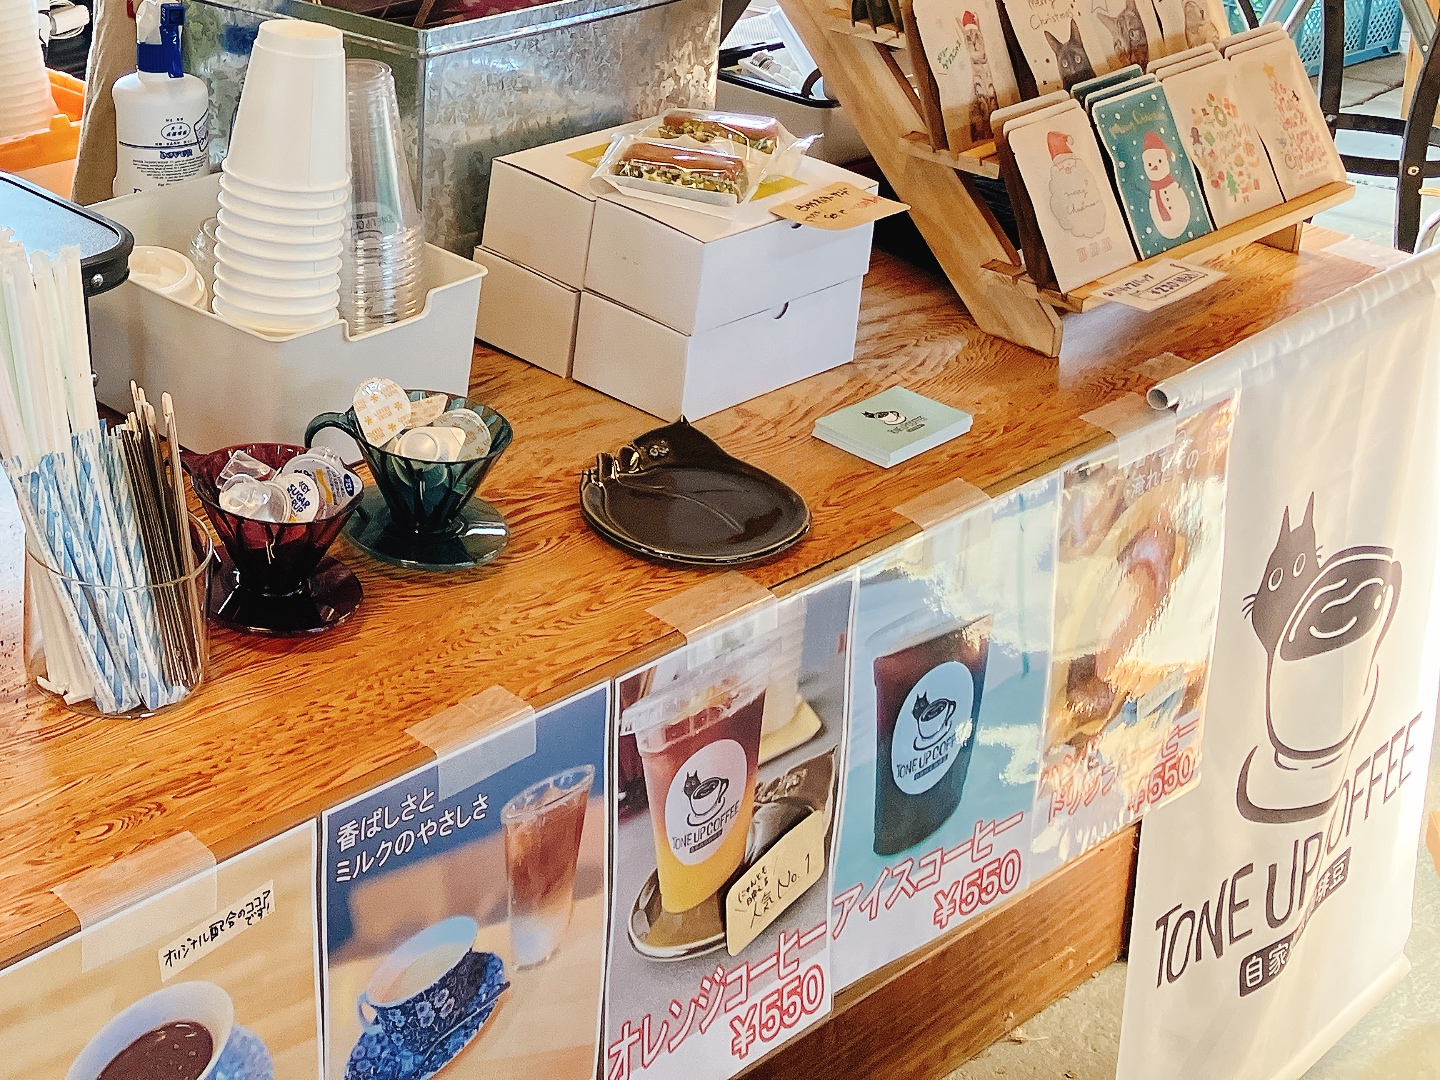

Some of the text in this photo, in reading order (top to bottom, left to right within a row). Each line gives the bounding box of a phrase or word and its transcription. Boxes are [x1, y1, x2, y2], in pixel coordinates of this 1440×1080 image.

[287, 484, 310, 509] SUGAR
[896, 755, 917, 779] TONE
[336, 787, 435, 852] 香ばしさと
[336, 793, 489, 883] ミルクのやさしさ
[1155, 711, 1423, 989] TONE UP OFFEE
[832, 811, 1024, 940] アイスコーヒー
[933, 849, 1021, 929] ¥550
[163, 889, 271, 967] オリジナル配合のココア
[608, 920, 827, 1080] オレンジコーヒー
[731, 963, 825, 1060] ¥550
